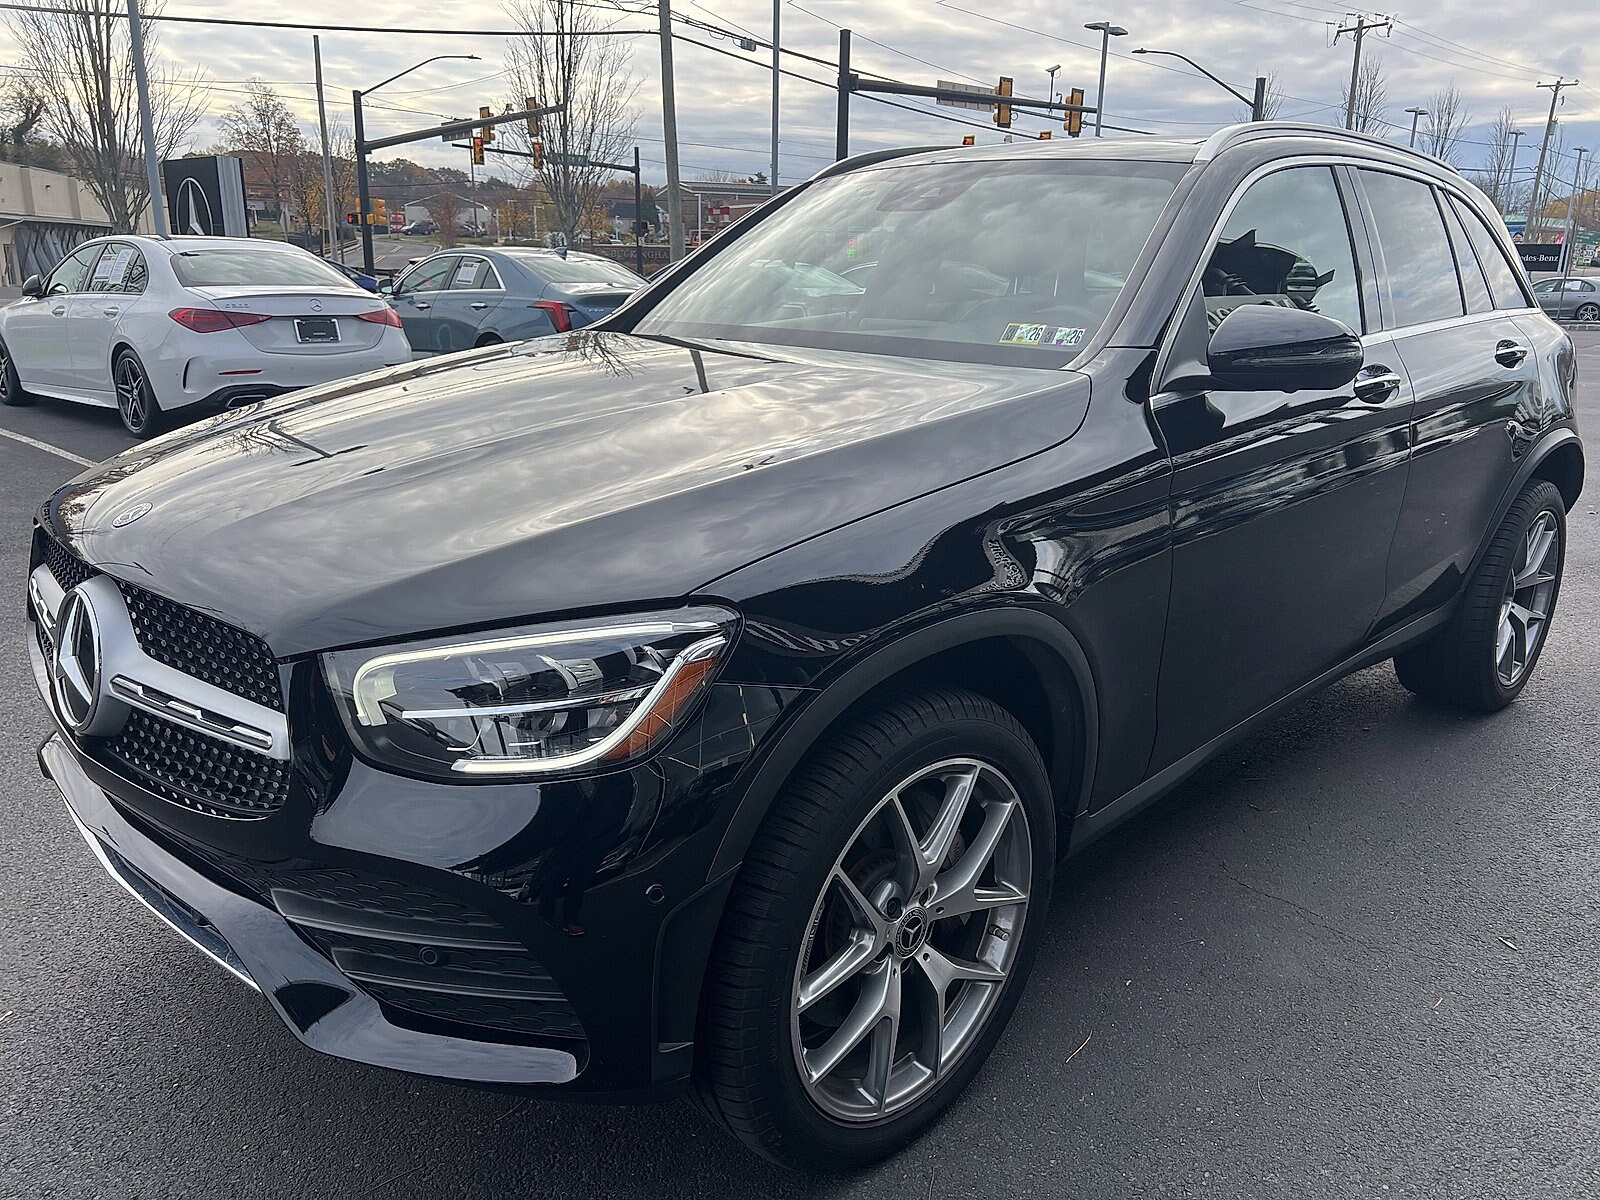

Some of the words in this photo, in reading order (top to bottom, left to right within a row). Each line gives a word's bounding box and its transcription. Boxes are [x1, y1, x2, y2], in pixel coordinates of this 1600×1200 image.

[611, 249, 668, 259] BUCKNGHA
[1028, 327, 1043, 341] 26
[1068, 329, 1083, 343] 26
